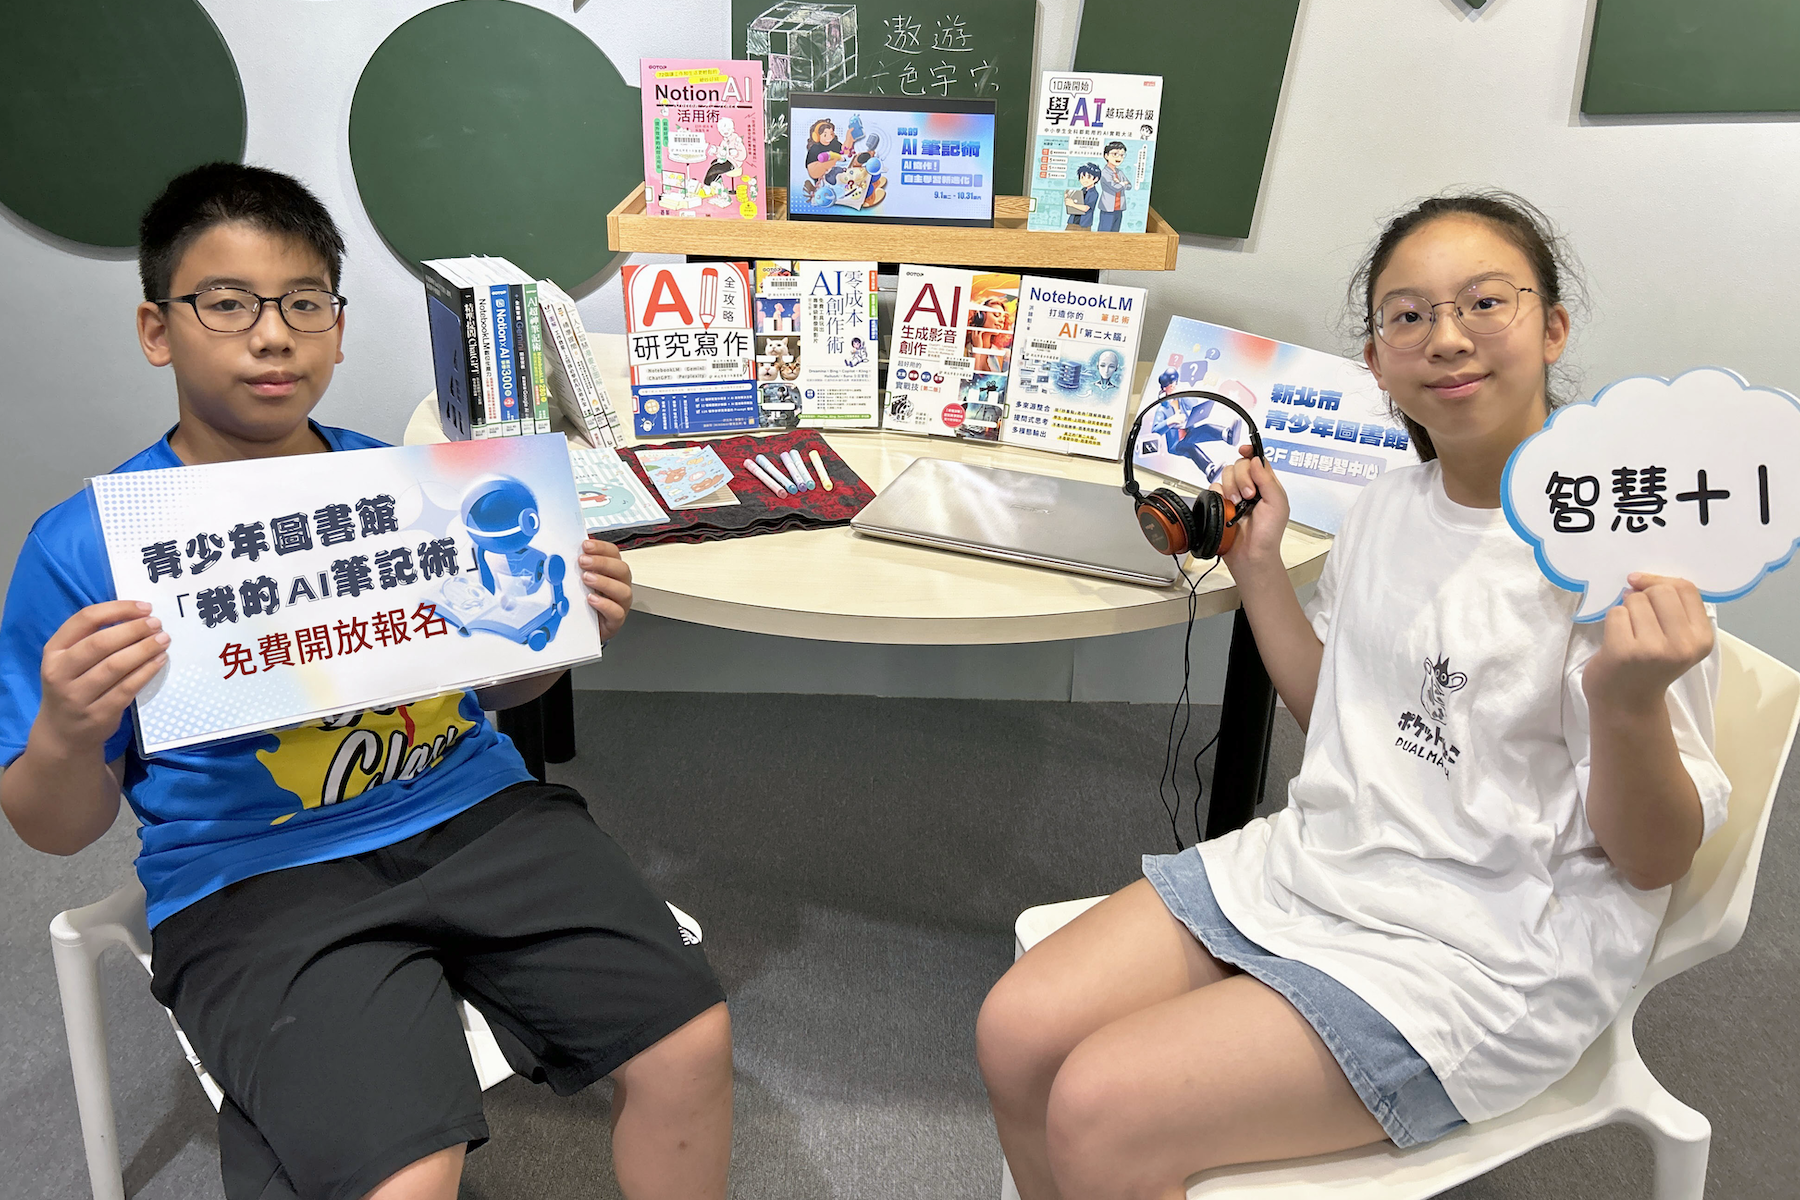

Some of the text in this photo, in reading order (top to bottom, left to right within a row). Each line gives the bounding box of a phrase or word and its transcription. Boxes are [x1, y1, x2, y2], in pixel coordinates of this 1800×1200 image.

[883, 14, 974, 54] 遨遊
[655, 76, 752, 103] Notion AI
[1053, 80, 1089, 92] 10歲開始
[677, 109, 720, 123] 活用術
[901, 138, 917, 156] AI
[809, 270, 845, 296] AI
[722, 276, 736, 323] 全攻略
[845, 270, 864, 328] 零成本
[903, 282, 962, 328] AI
[1030, 286, 1133, 312] NotebookLM
[478, 298, 491, 350] NotebookLM
[826, 296, 845, 355] 創作術
[1049, 308, 1084, 321] 打造你的
[901, 325, 957, 345] 生成影音
[1058, 322, 1078, 339] AI
[632, 331, 749, 360] 研究寫作
[899, 340, 928, 357] 創作
[1270, 383, 1343, 411] 新北市
[1264, 409, 1409, 451] 青少年圖書館
[1264, 446, 1380, 481] 2F 創新學習中心
[141, 494, 399, 583] 青少年圖書館
[218, 602, 449, 681] 免費開放報名
